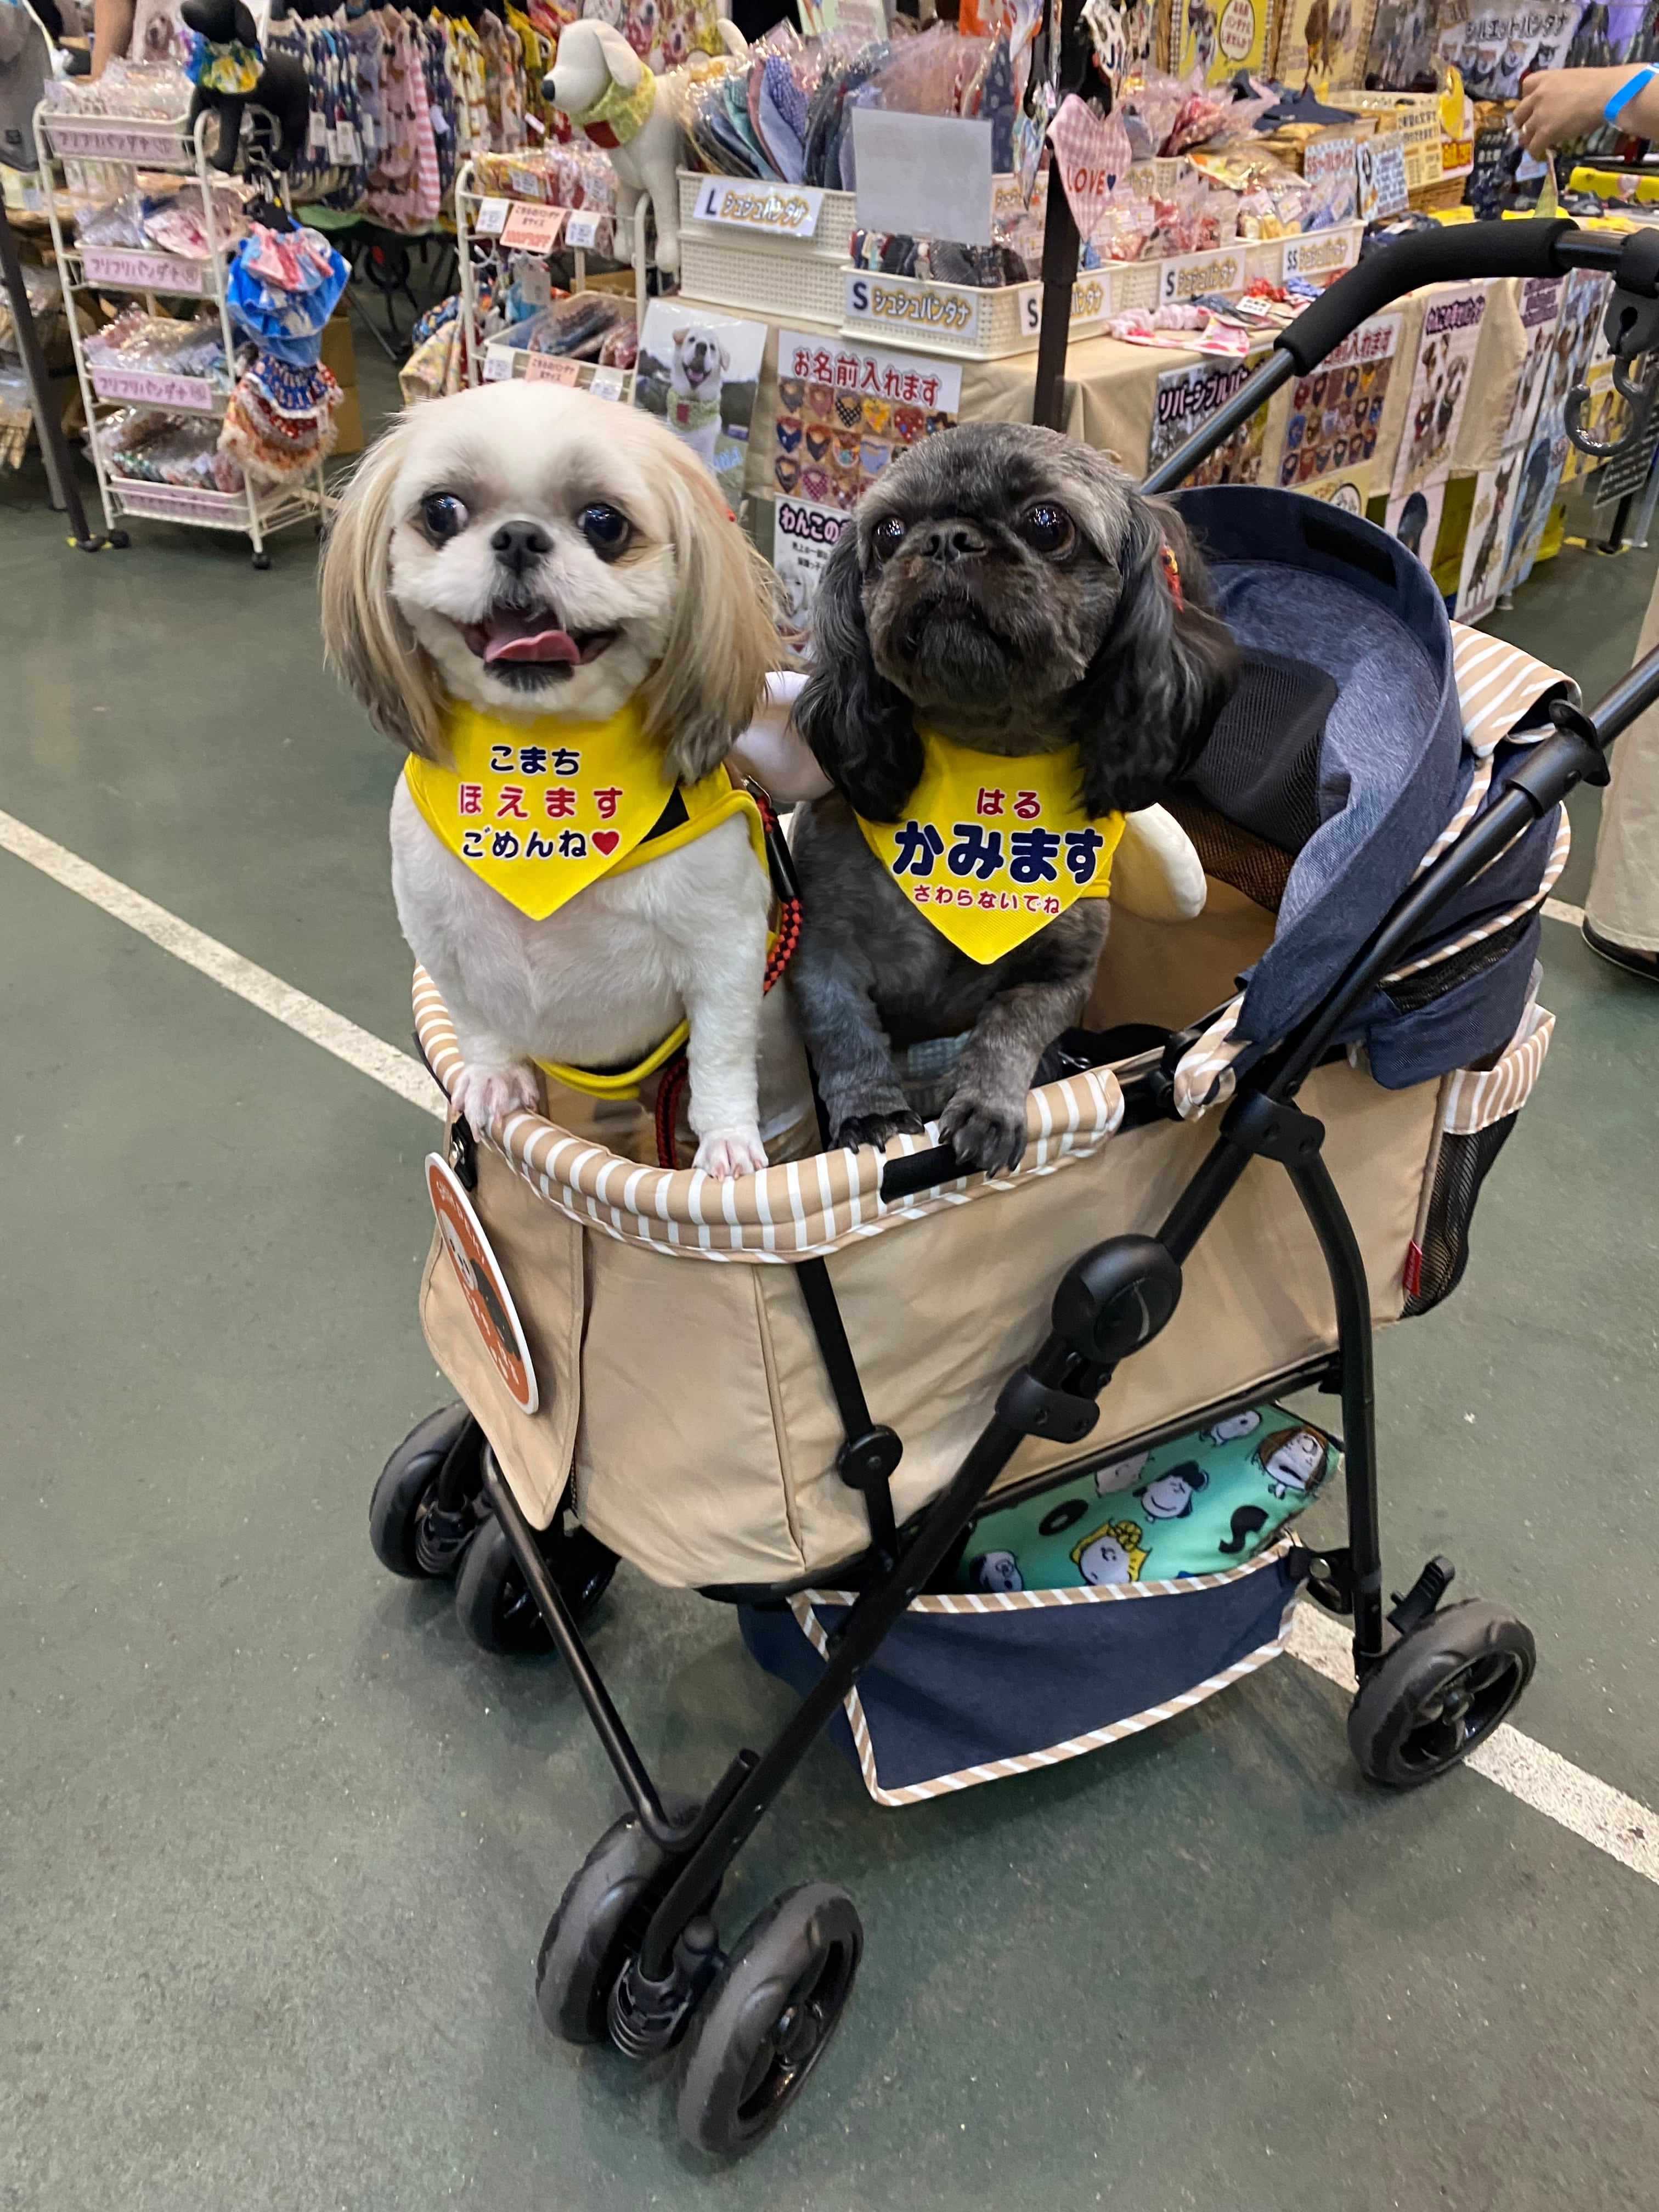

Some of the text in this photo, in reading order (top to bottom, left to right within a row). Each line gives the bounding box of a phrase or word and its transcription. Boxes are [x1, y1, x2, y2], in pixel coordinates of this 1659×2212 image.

[1066, 166, 1107, 196] LOVE
[704, 188, 808, 227] L シュシュバンダナ
[1288, 249, 1298, 270] SS
[1165, 271, 1175, 297] S
[853, 281, 970, 327] S シュシュバンダナ
[1027, 298, 1039, 328] S
[793, 349, 939, 407] お名前入れます
[780, 503, 848, 545] わんこの
[490, 745, 581, 776] こまち
[459, 783, 624, 820] ほえます
[977, 787, 1041, 819] はる
[462, 826, 588, 859] ごめんね
[891, 821, 1104, 884] かみます
[913, 885, 1062, 915] さわらないでね
